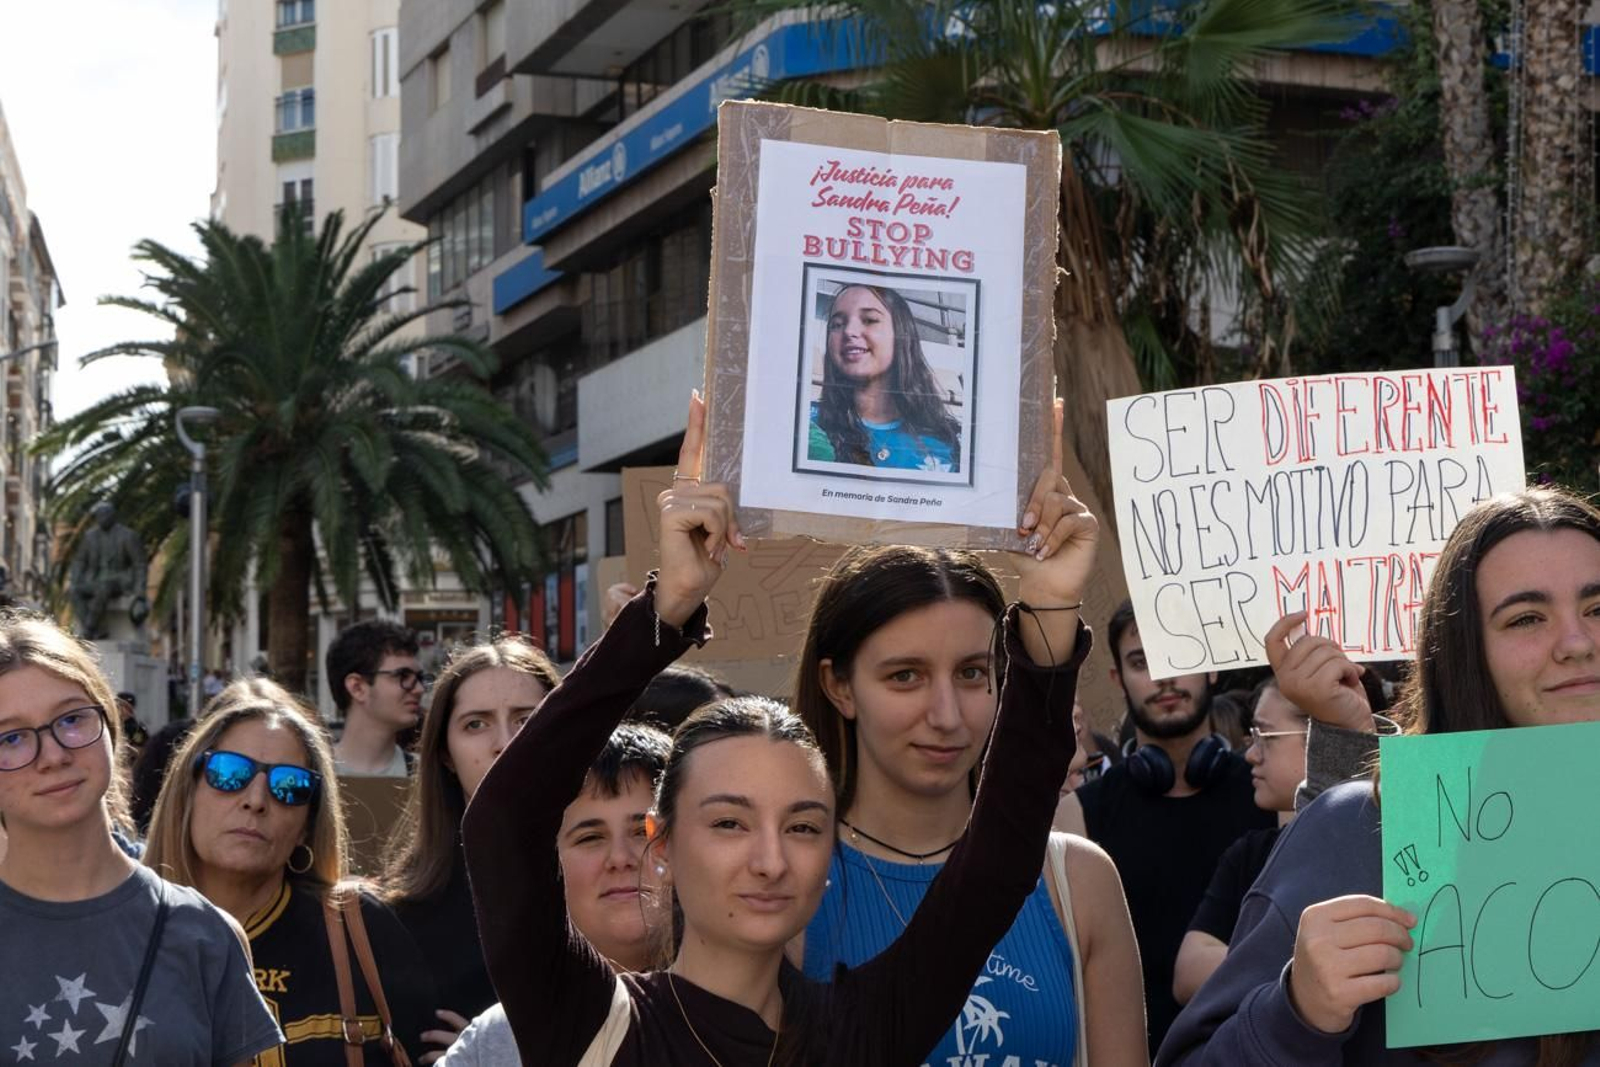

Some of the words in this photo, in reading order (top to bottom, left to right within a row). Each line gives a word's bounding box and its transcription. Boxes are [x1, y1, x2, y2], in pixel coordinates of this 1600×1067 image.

[810, 160, 898, 187] ¡Justicia
[898, 174, 954, 195] para
[811, 186, 891, 213] Sandra
[892, 193, 961, 219] Peña!
[847, 216, 933, 246] STOP
[802, 234, 975, 273] BULLYING
[1125, 387, 1236, 483] SER
[821, 488, 834, 498] En
[835, 491, 874, 502] memoria
[874, 494, 886, 503] de
[887, 495, 919, 505] Sandra
[920, 497, 943, 507] Peña
[1131, 489, 1183, 580] NO
[1190, 480, 1239, 570] ES
[1245, 460, 1370, 561] MOTIVO
[1384, 454, 1494, 546] PARA
[1154, 571, 1267, 670] SER
